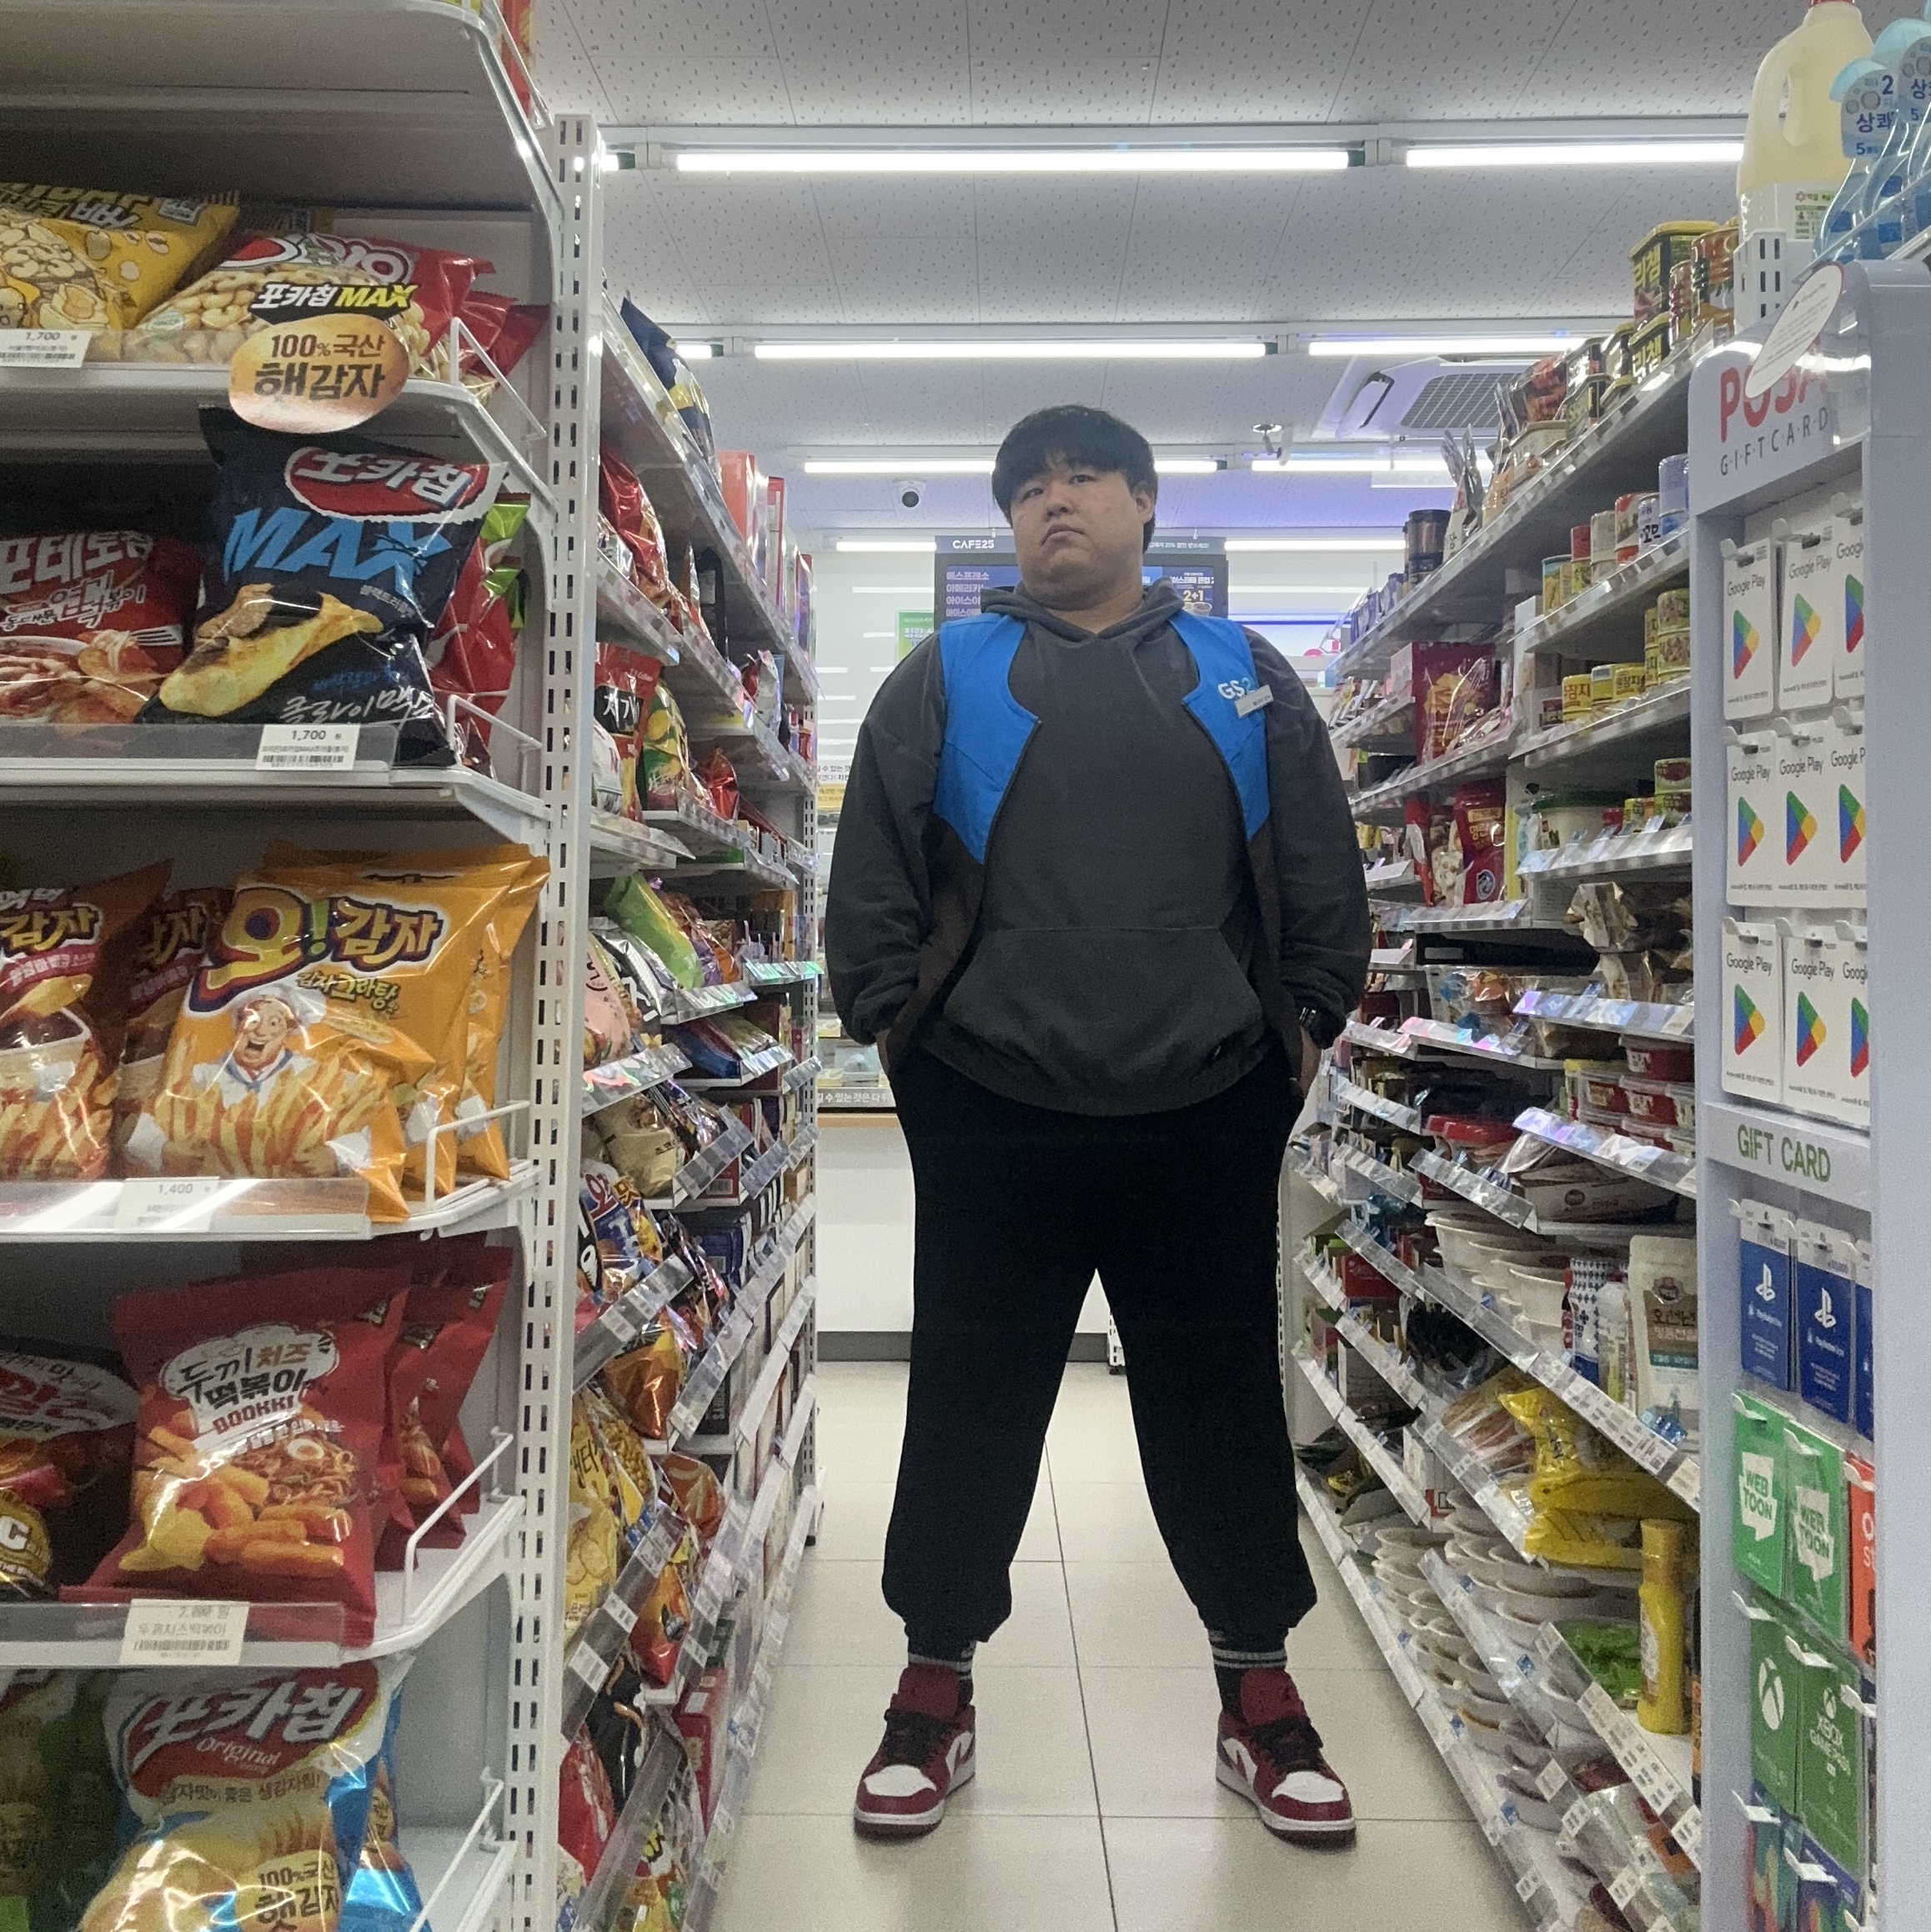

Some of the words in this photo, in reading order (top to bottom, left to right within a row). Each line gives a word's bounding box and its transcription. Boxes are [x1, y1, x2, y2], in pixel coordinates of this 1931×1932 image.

[1910, 78, 1931, 99] 상
[250, 284, 338, 309] 포카칩
[335, 284, 418, 309] MAX
[25, 331, 61, 341] 1,700
[253, 362, 386, 401] 해감자
[294, 453, 472, 508] 포카칩
[223, 506, 453, 593] MAX
[952, 539, 995, 549] CAFE25
[1788, 560, 1817, 580] Google
[1816, 555, 1832, 575] Play
[1183, 590, 1204, 601] 2+1
[1727, 580, 1751, 598] Google
[1752, 574, 1766, 591] Play
[292, 730, 326, 741] 1,700
[1779, 758, 1806, 777] Google
[1807, 756, 1823, 775] Play
[1831, 749, 1858, 770] Google
[1731, 765, 1755, 784] Google
[1756, 764, 1771, 782] Play
[206, 886, 438, 991] 오!감자
[1726, 952, 1754, 973] Google
[1756, 956, 1773, 976] Play
[1792, 958, 1818, 980] Google
[1818, 960, 1834, 980] Play
[825, 1092, 834, 1103] 수
[835, 1092, 852, 1103] 있는
[871, 1092, 880, 1103] 다
[1737, 1124, 1774, 1165] GIFT
[1780, 1137, 1831, 1182] CARD
[158, 1182, 193, 1196] 1,400
[177, 1347, 253, 1404] 두끼
[257, 1342, 312, 1369] 치즈
[203, 1368, 308, 1410] 떡볶이
[212, 1395, 295, 1435] DOOKKI
[1745, 1471, 1769, 1498] WEB
[1742, 1487, 1773, 1520] TOON
[132, 1681, 364, 1770] 포카칩
[195, 1737, 282, 1766] Original
